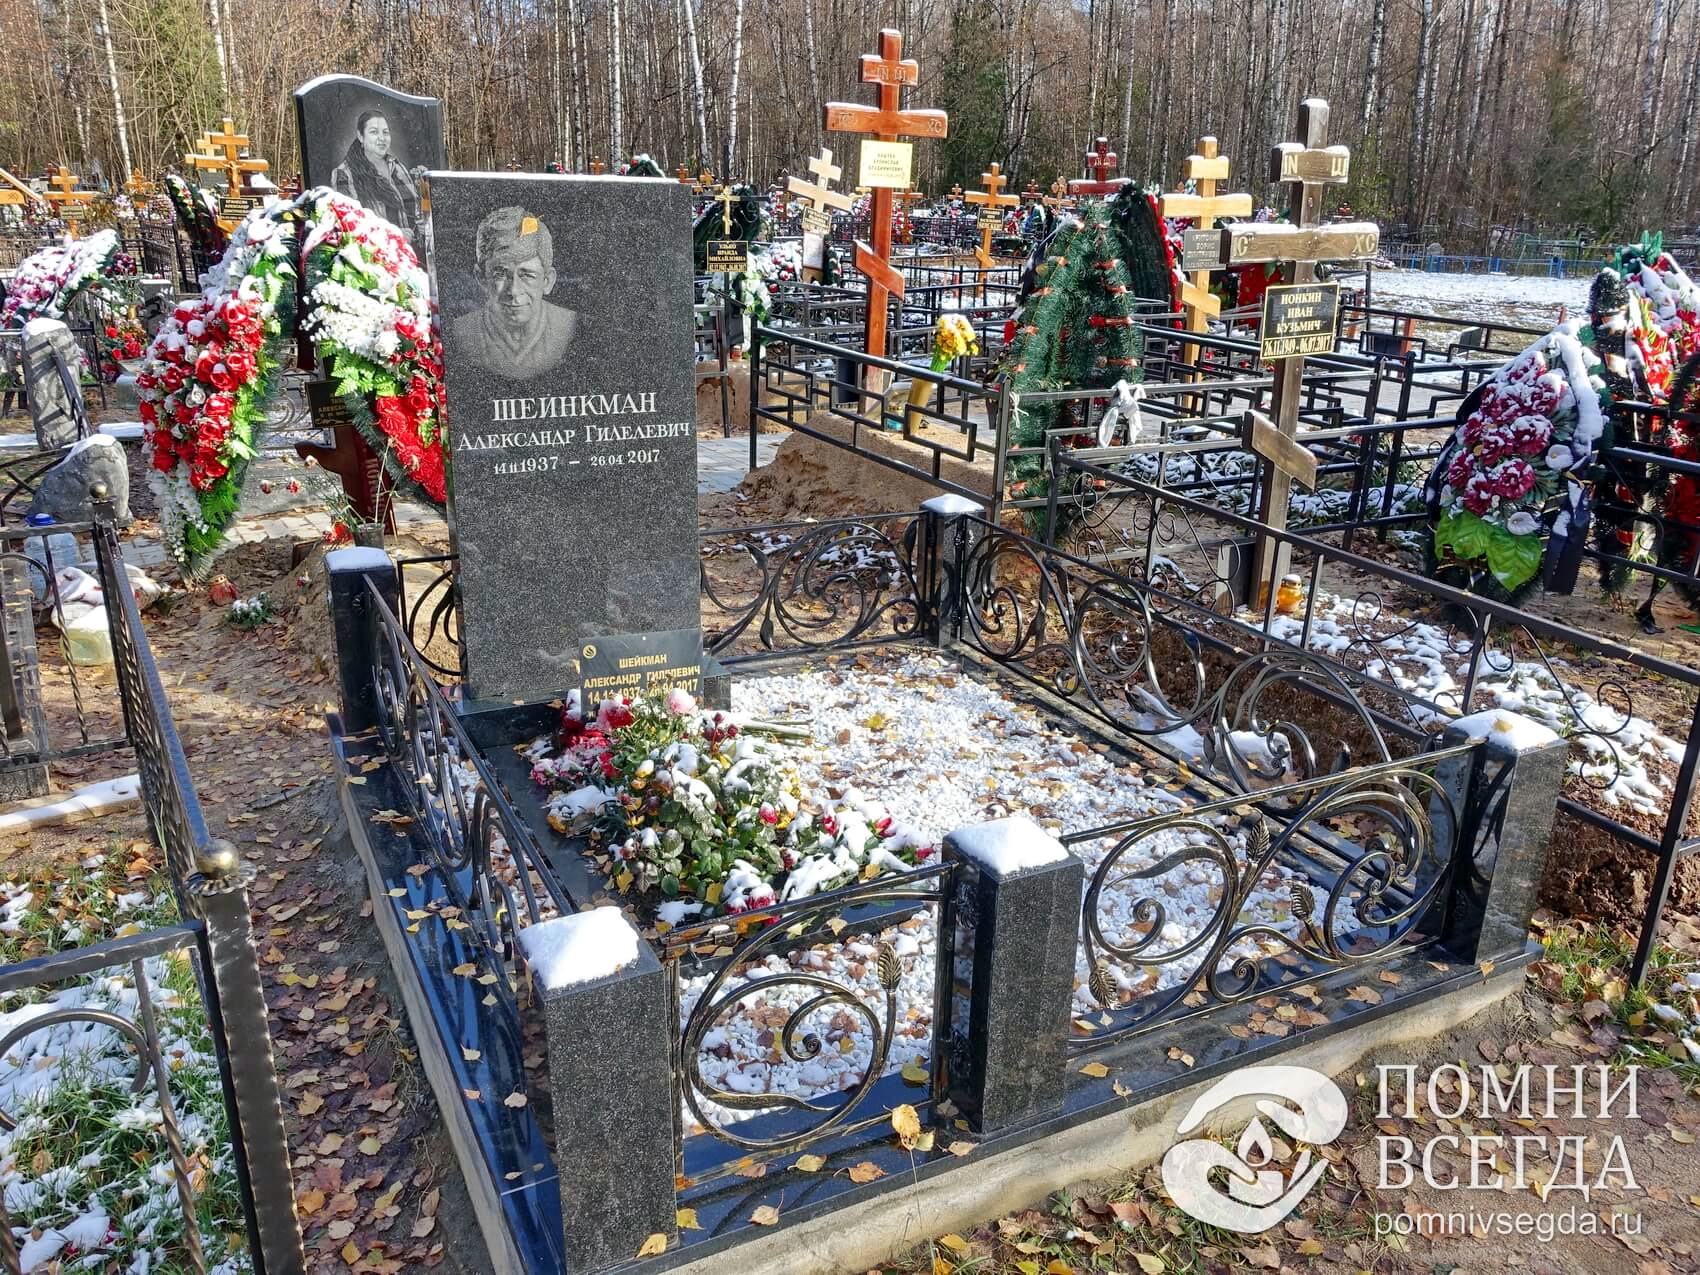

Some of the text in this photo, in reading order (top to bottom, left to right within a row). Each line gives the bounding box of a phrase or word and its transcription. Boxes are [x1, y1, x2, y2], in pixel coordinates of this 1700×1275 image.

[458, 422, 691, 451] АЛЕКСАНДР ГИЛЕЛЕВИЧ
[584, 672, 642, 689] АЛЕКСАНДР
